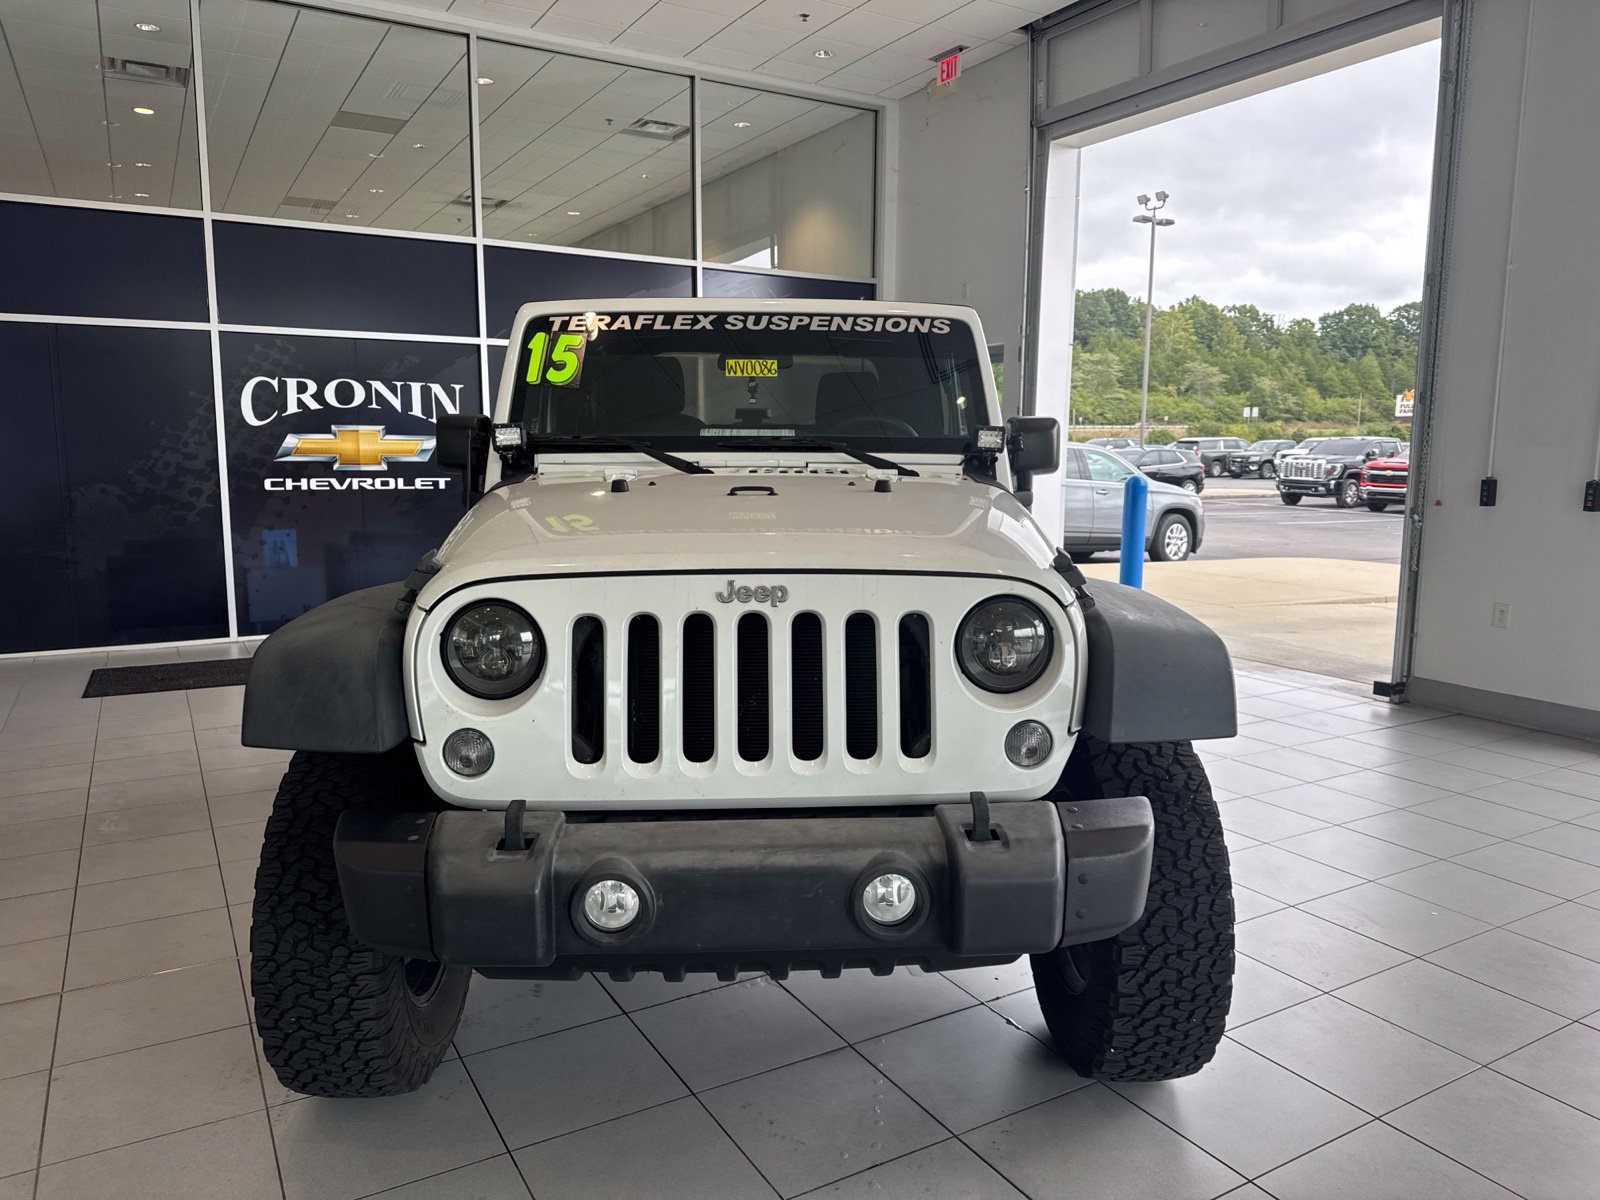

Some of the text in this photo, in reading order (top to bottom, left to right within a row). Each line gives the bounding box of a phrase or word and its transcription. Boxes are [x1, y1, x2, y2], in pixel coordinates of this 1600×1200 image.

[940, 54, 959, 83] EXIT
[548, 314, 951, 335] TERAFLEX SUSPENSIONS
[526, 331, 584, 386] 15
[240, 375, 464, 427] CRONIN
[263, 477, 452, 491] CHEVROLET
[714, 579, 789, 607] Jeep
